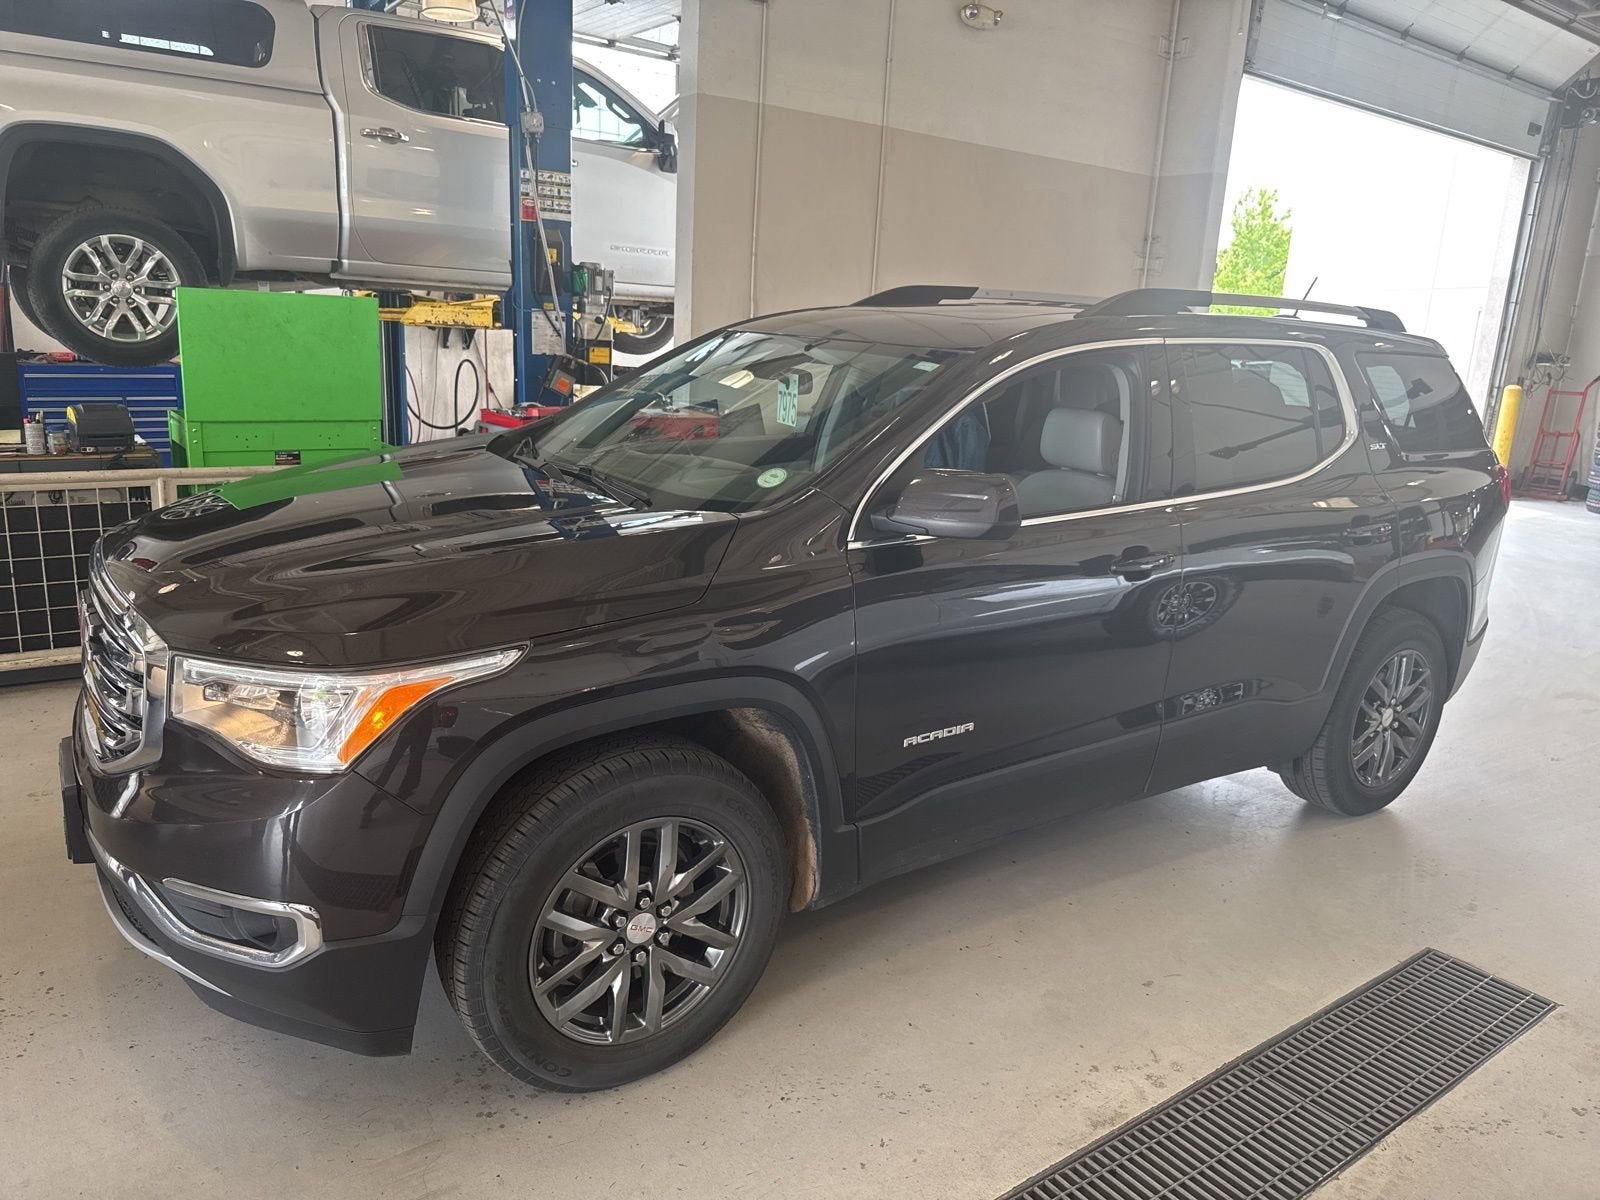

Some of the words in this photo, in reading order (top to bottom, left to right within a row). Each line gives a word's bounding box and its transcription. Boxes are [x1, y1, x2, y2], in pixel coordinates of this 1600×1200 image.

[778, 391, 797, 425] 7975
[903, 722, 975, 748] ACADIA
[629, 924, 654, 933] GMC
